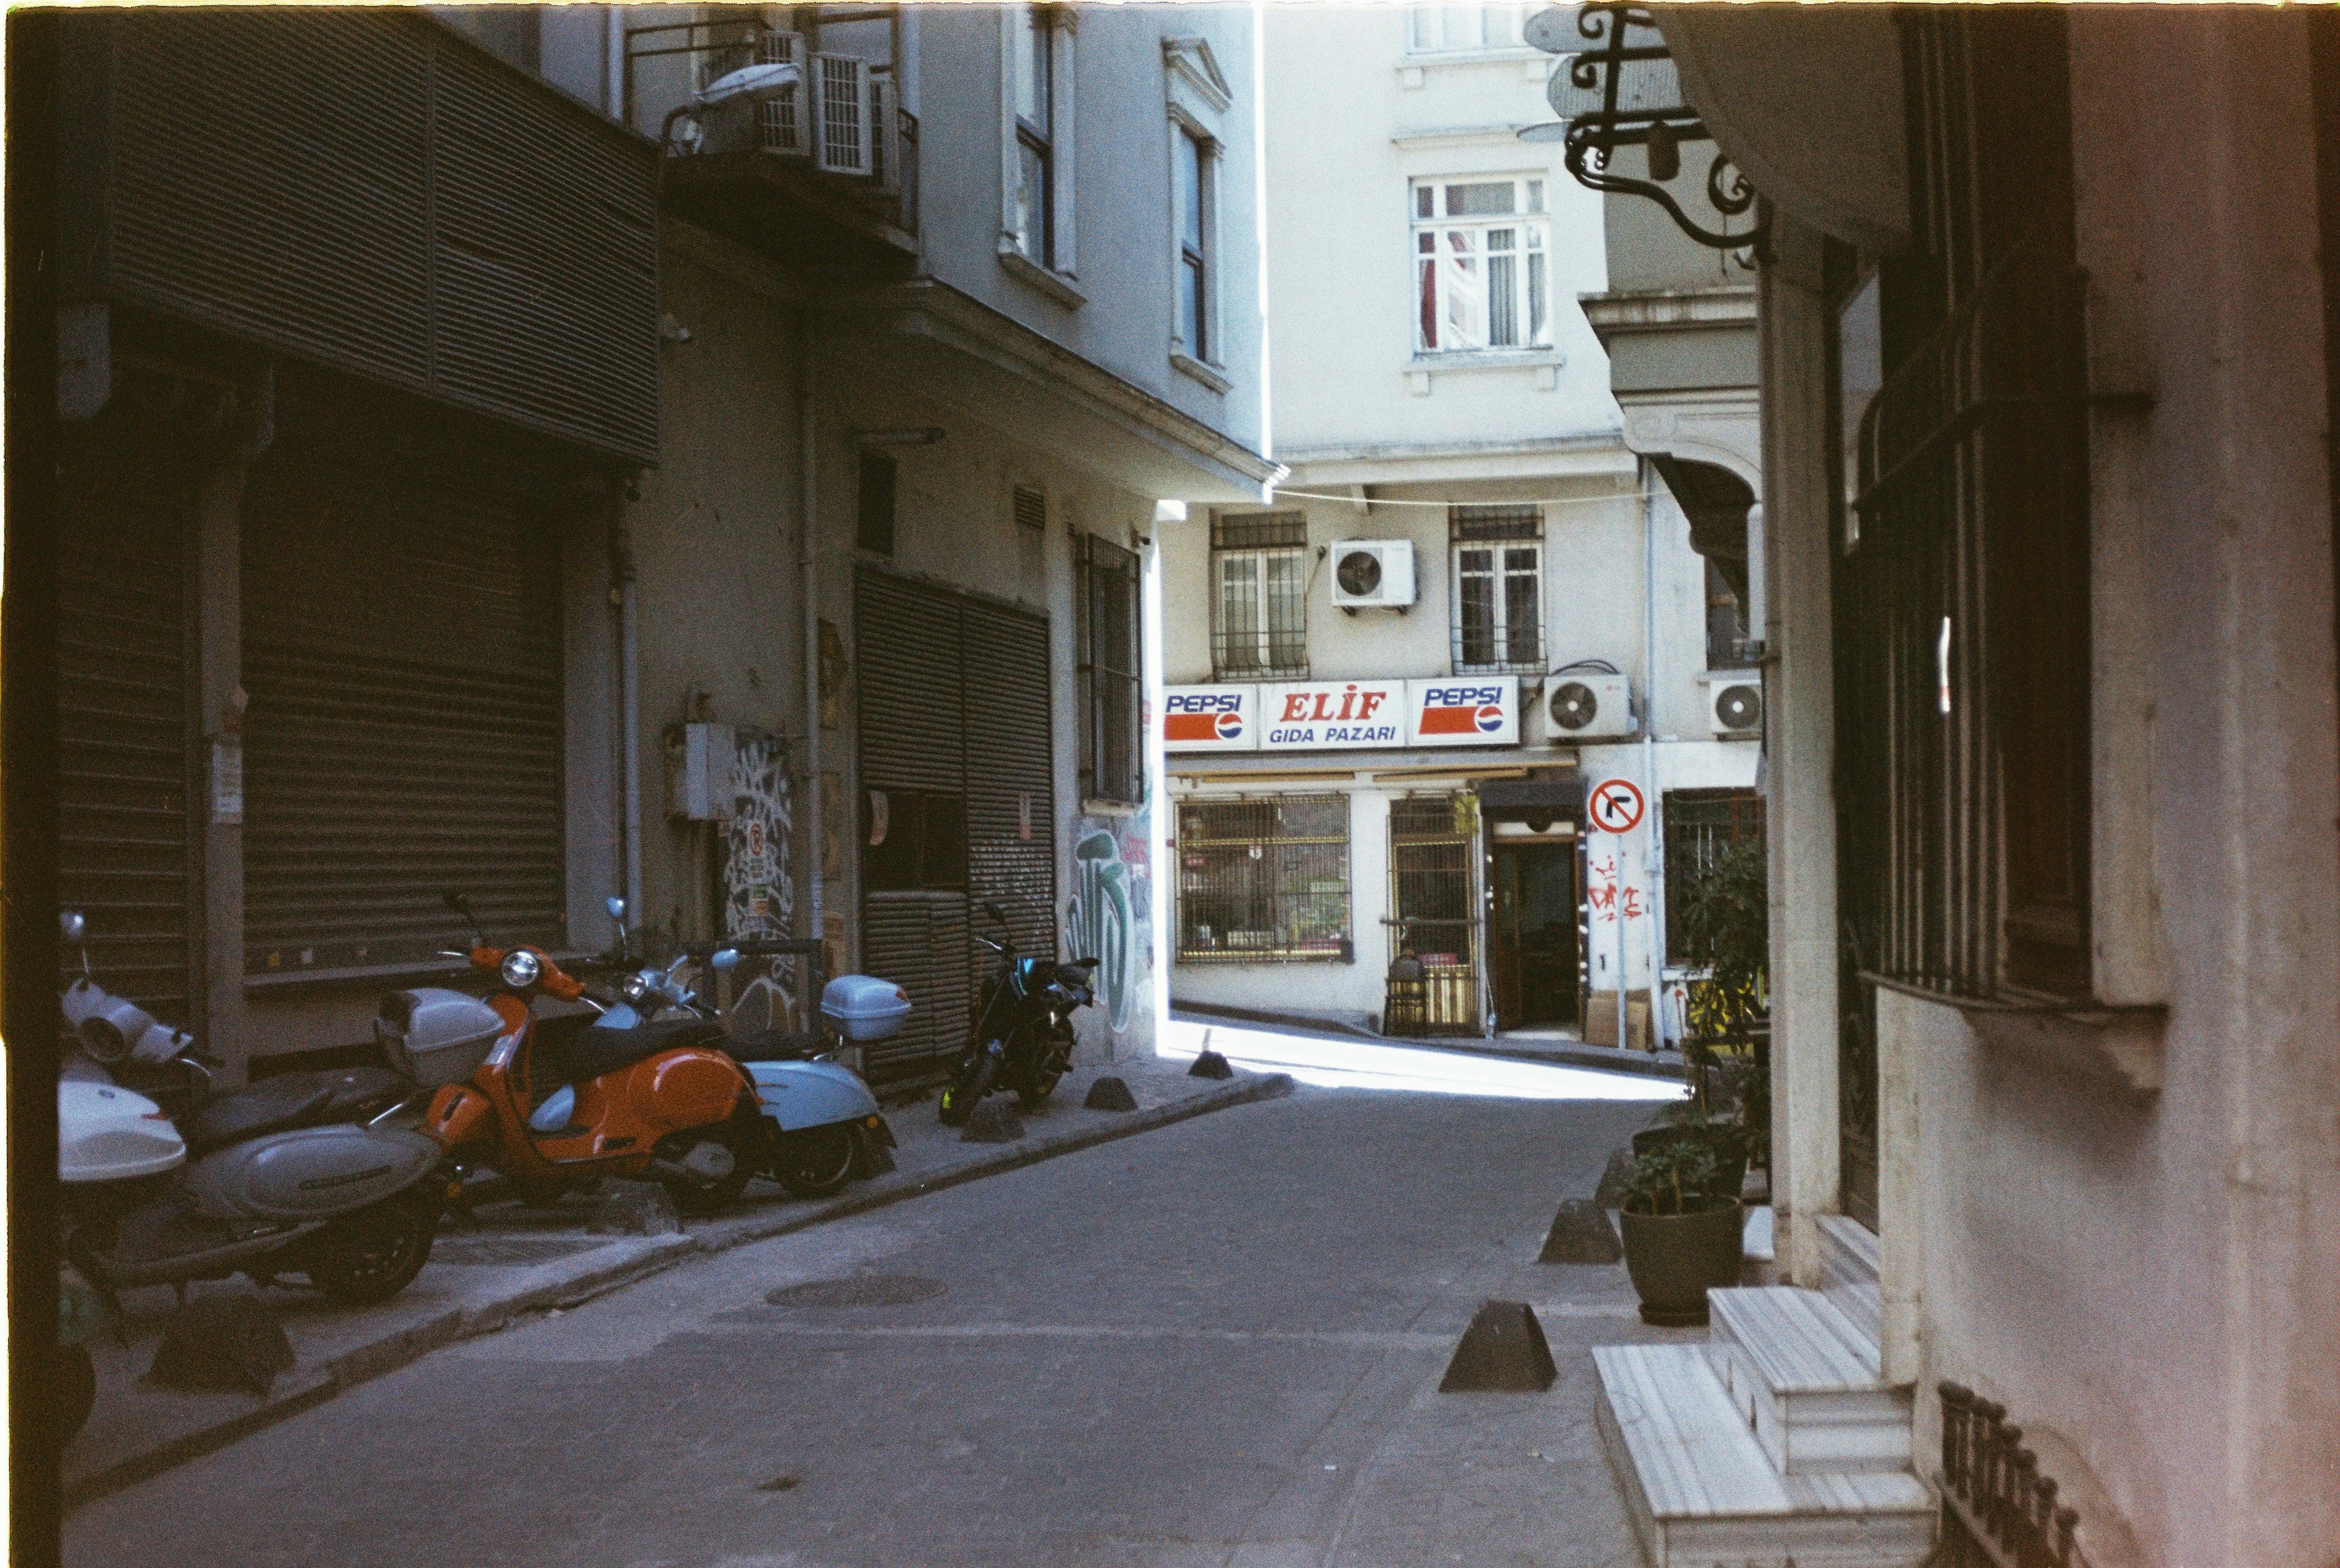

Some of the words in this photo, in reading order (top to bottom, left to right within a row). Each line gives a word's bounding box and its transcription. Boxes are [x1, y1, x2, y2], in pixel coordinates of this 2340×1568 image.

[1166, 695, 1242, 713] PEPSI
[1280, 684, 1387, 722] ELİF
[1424, 686, 1503, 707] PEPSI
[1270, 729, 1314, 743] GIDA
[1325, 726, 1396, 741] PAZARI
